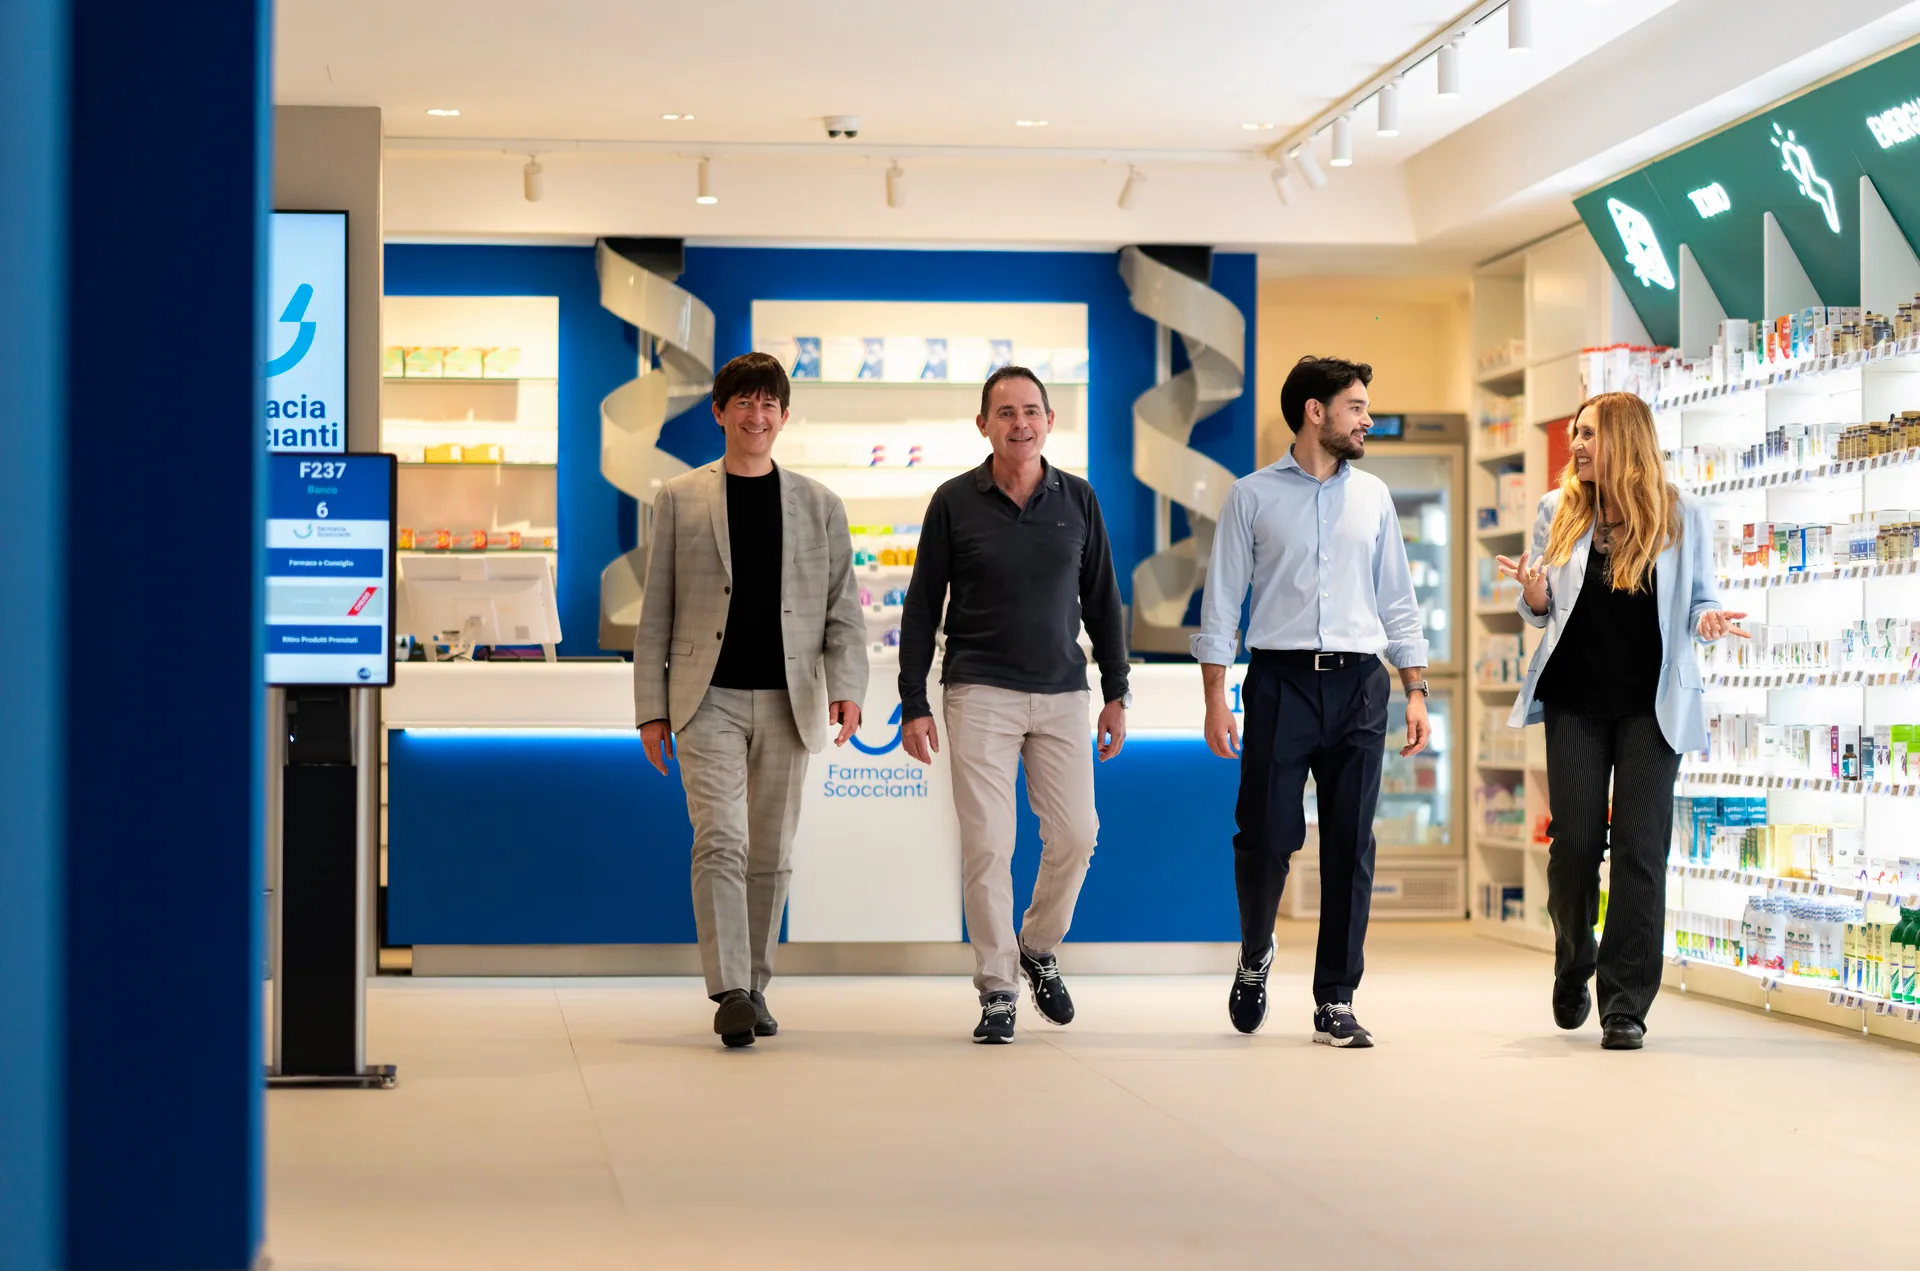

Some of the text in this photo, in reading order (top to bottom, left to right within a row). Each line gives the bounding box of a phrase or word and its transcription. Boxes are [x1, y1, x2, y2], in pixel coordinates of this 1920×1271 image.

[300, 461, 346, 479] F237
[308, 485, 337, 495] Banco
[316, 501, 329, 518] 6
[288, 559, 318, 567] Farmaco
[324, 559, 354, 568] Consiglio
[301, 635, 327, 644] Prodotti
[328, 635, 358, 644] Prenotati
[1230, 683, 1243, 713] 1
[828, 763, 923, 780] Farmacia
[823, 780, 928, 798] Scoccianti
